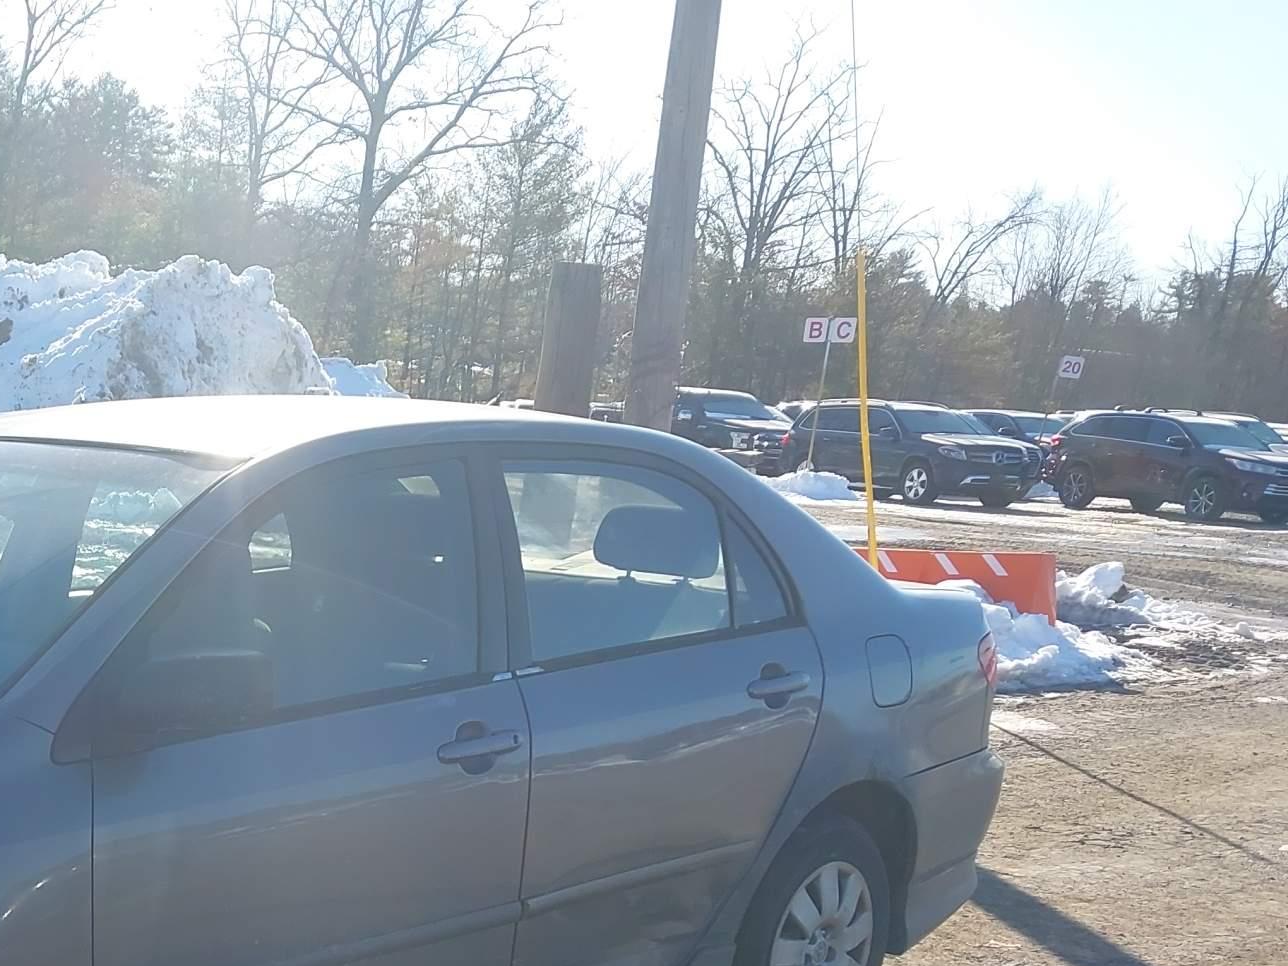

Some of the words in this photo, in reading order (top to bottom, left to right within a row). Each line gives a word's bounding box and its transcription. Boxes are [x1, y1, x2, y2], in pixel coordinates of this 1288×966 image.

[808, 321, 823, 339] B
[837, 321, 852, 339] C
[1062, 360, 1081, 374] 20
